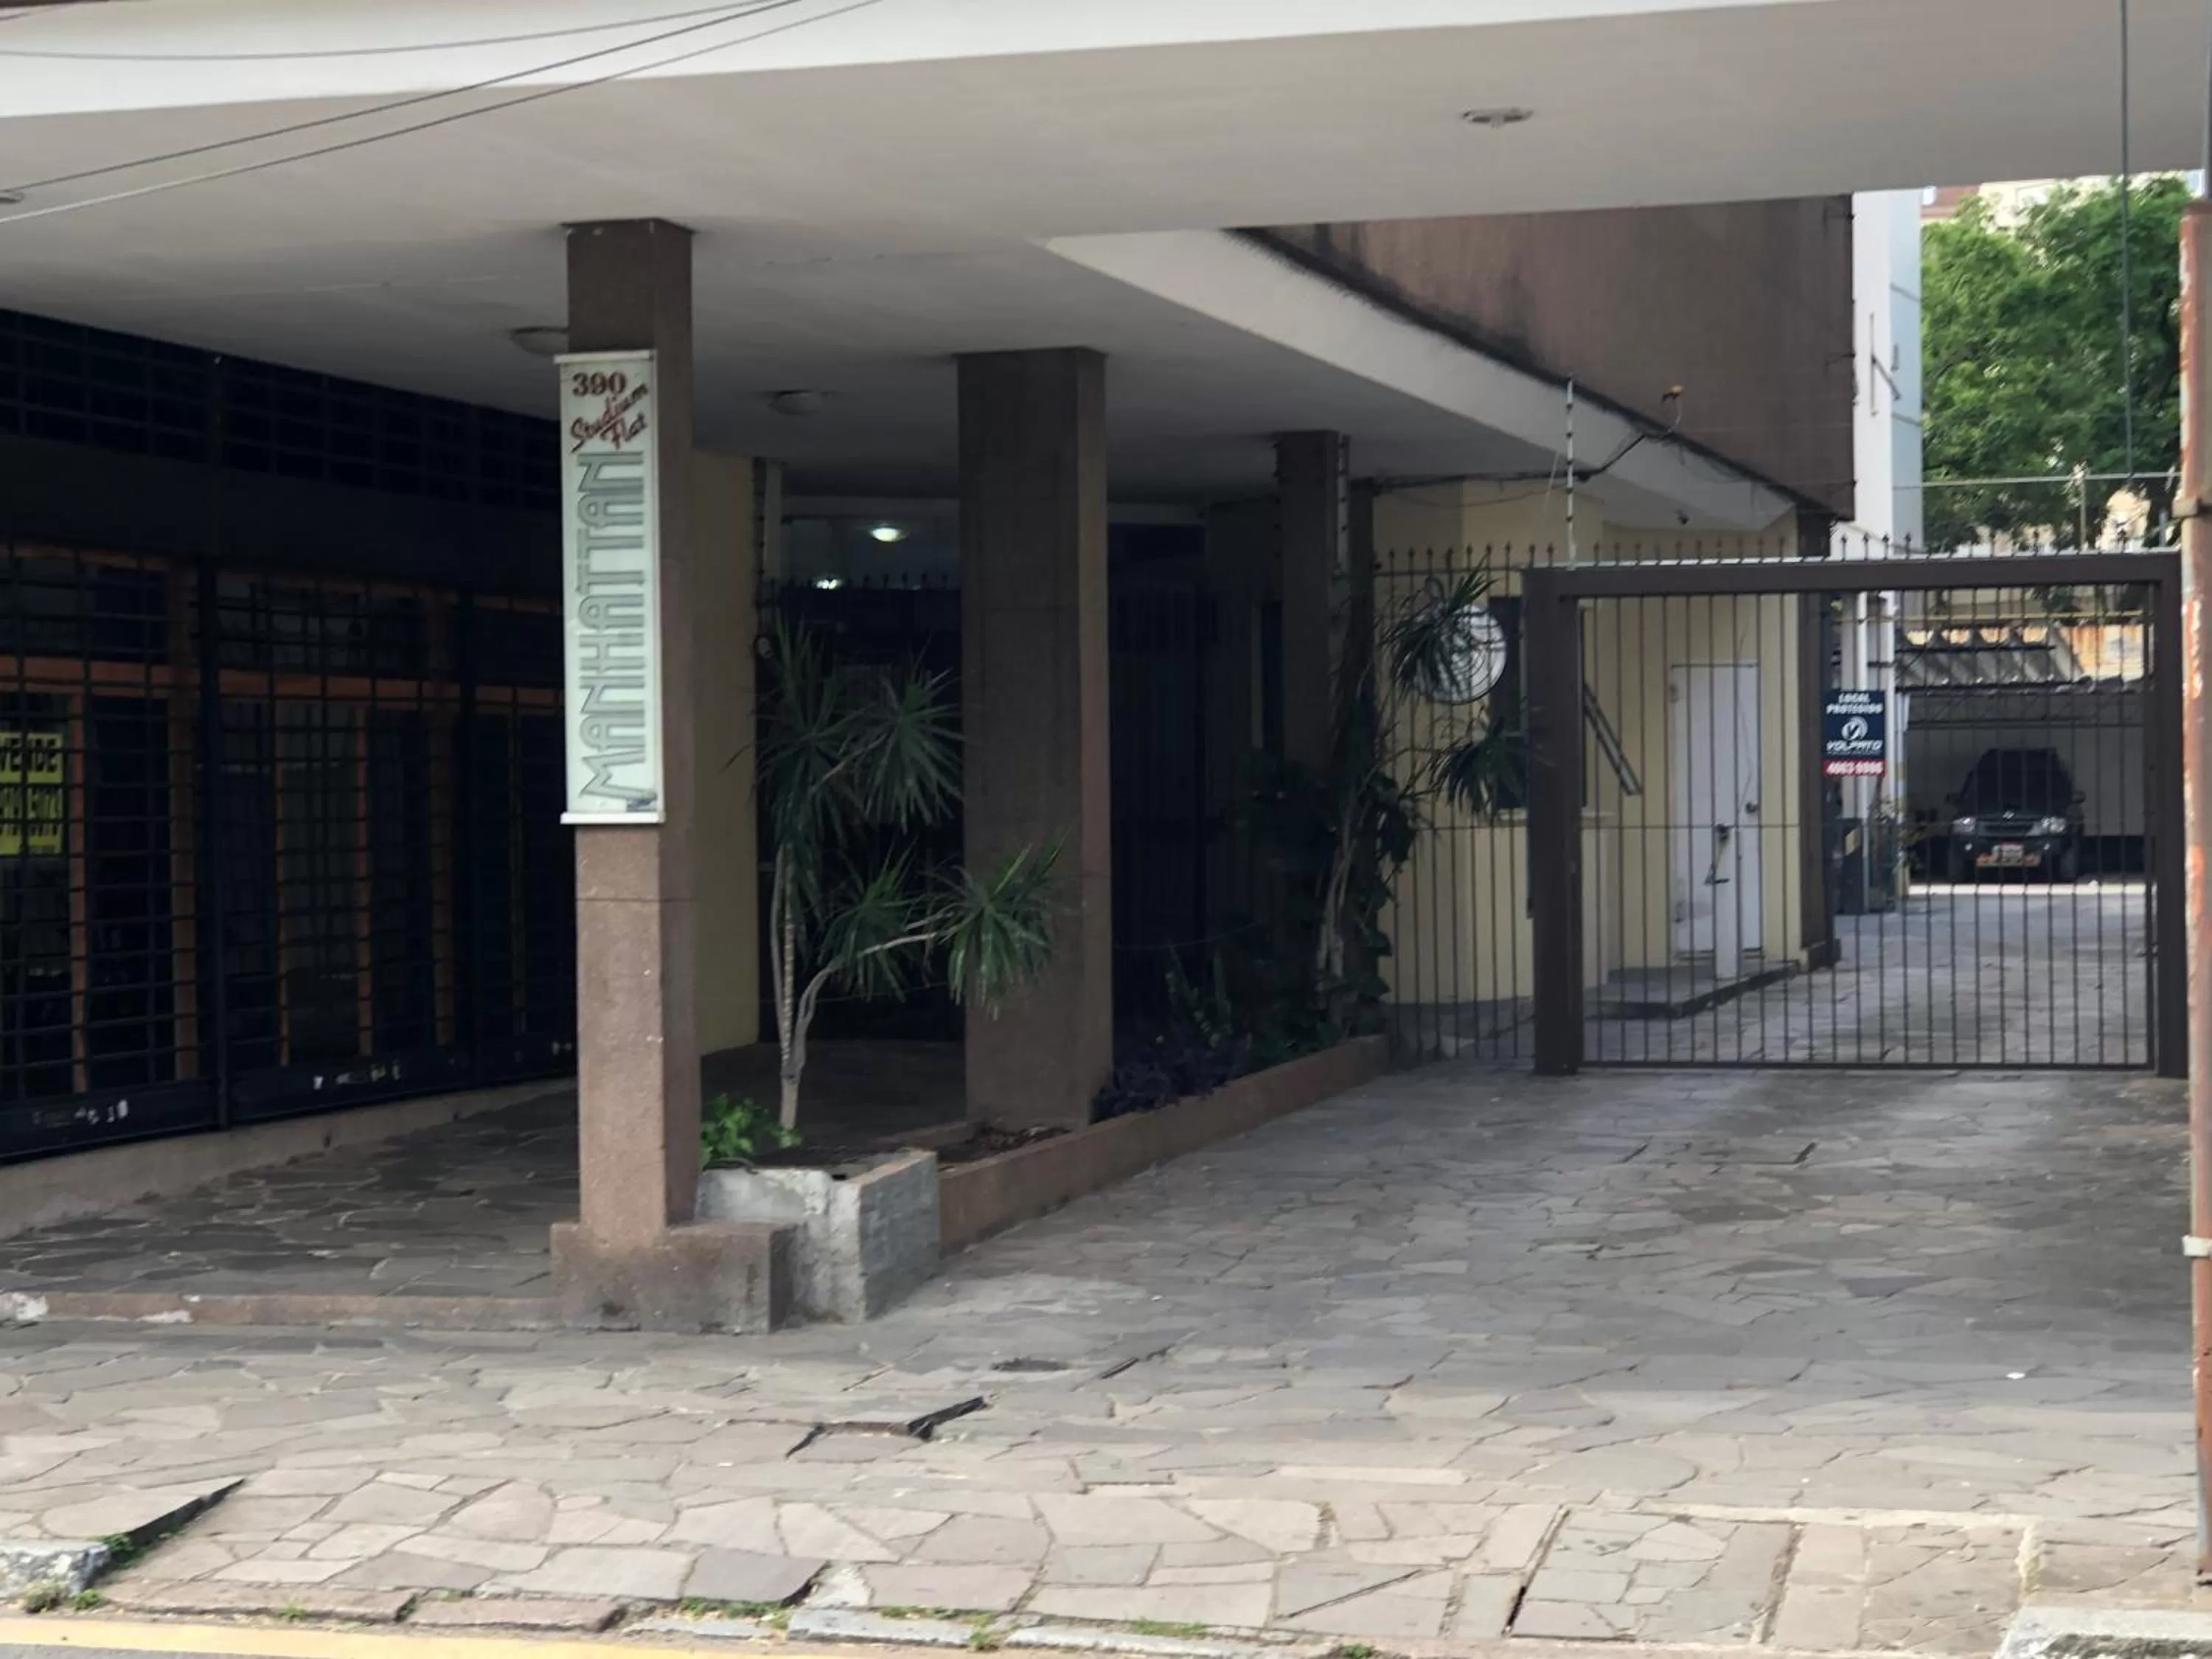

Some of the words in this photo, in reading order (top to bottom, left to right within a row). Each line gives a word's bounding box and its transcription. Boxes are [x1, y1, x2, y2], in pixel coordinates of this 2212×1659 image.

[571, 371, 627, 397] 390
[600, 412, 647, 450] Flat
[577, 451, 656, 799] MANHATTAN
[1839, 692, 1870, 703] LOCAL
[1826, 703, 1883, 714] PROTEGIDO
[1826, 740, 1883, 751] VOLPATO
